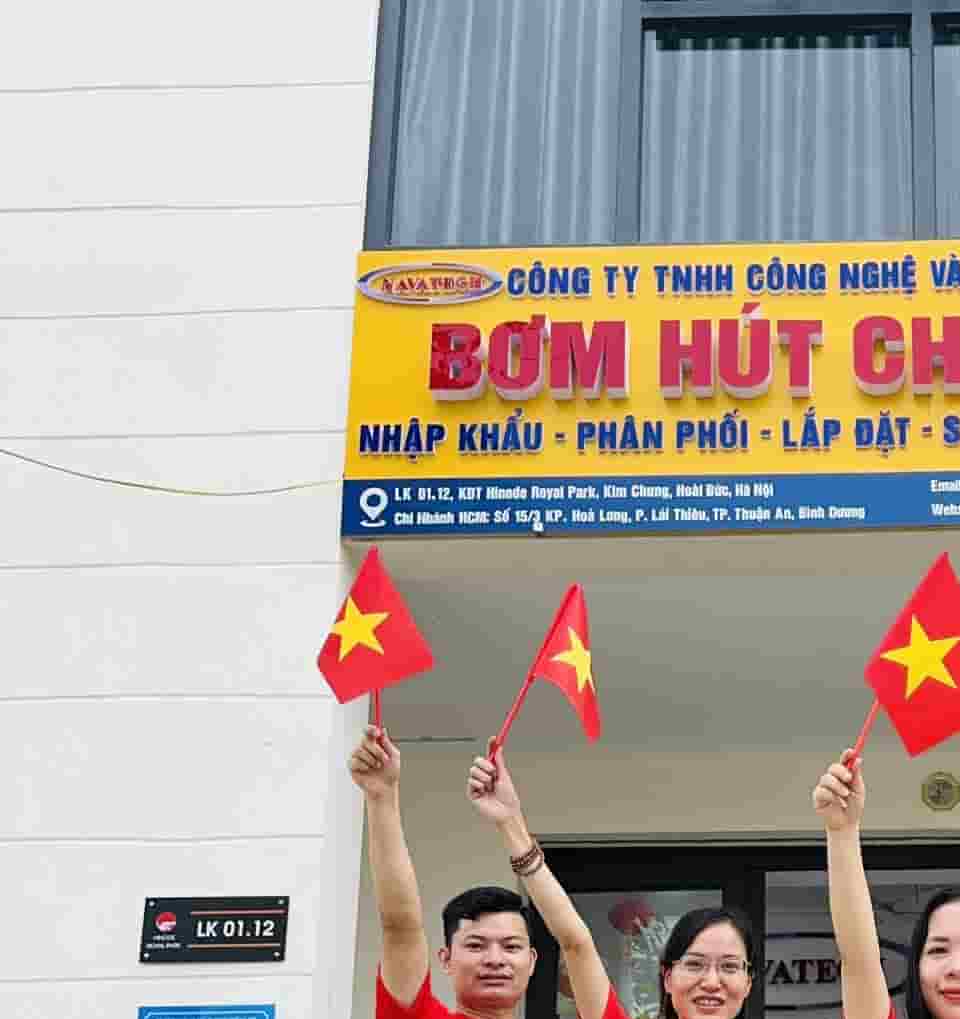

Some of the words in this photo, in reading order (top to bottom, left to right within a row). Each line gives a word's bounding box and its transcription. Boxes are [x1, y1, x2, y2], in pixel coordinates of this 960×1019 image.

[507, 260, 591, 297] CÔNG
[603, 265, 639, 297] TY
[654, 264, 734, 295] TNHH
[746, 255, 828, 295] CÔNG
[839, 254, 918, 298] NGHỆ
[429, 313, 630, 399] BƠM
[659, 302, 824, 399] HÚT
[359, 417, 446, 462] NHẬP
[458, 407, 545, 455] KHẨU
[576, 414, 665, 454] PHÂN
[675, 408, 749, 453] PHỐI
[782, 406, 842, 452] LẮP
[854, 408, 911, 458] ĐẶT
[394, 487, 413, 502] LK
[531, 484, 564, 502] Royal
[603, 483, 627, 498] Kim
[494, 507, 511, 523] Số
[196, 920, 219, 937] LK
[222, 919, 275, 937] 01.12
